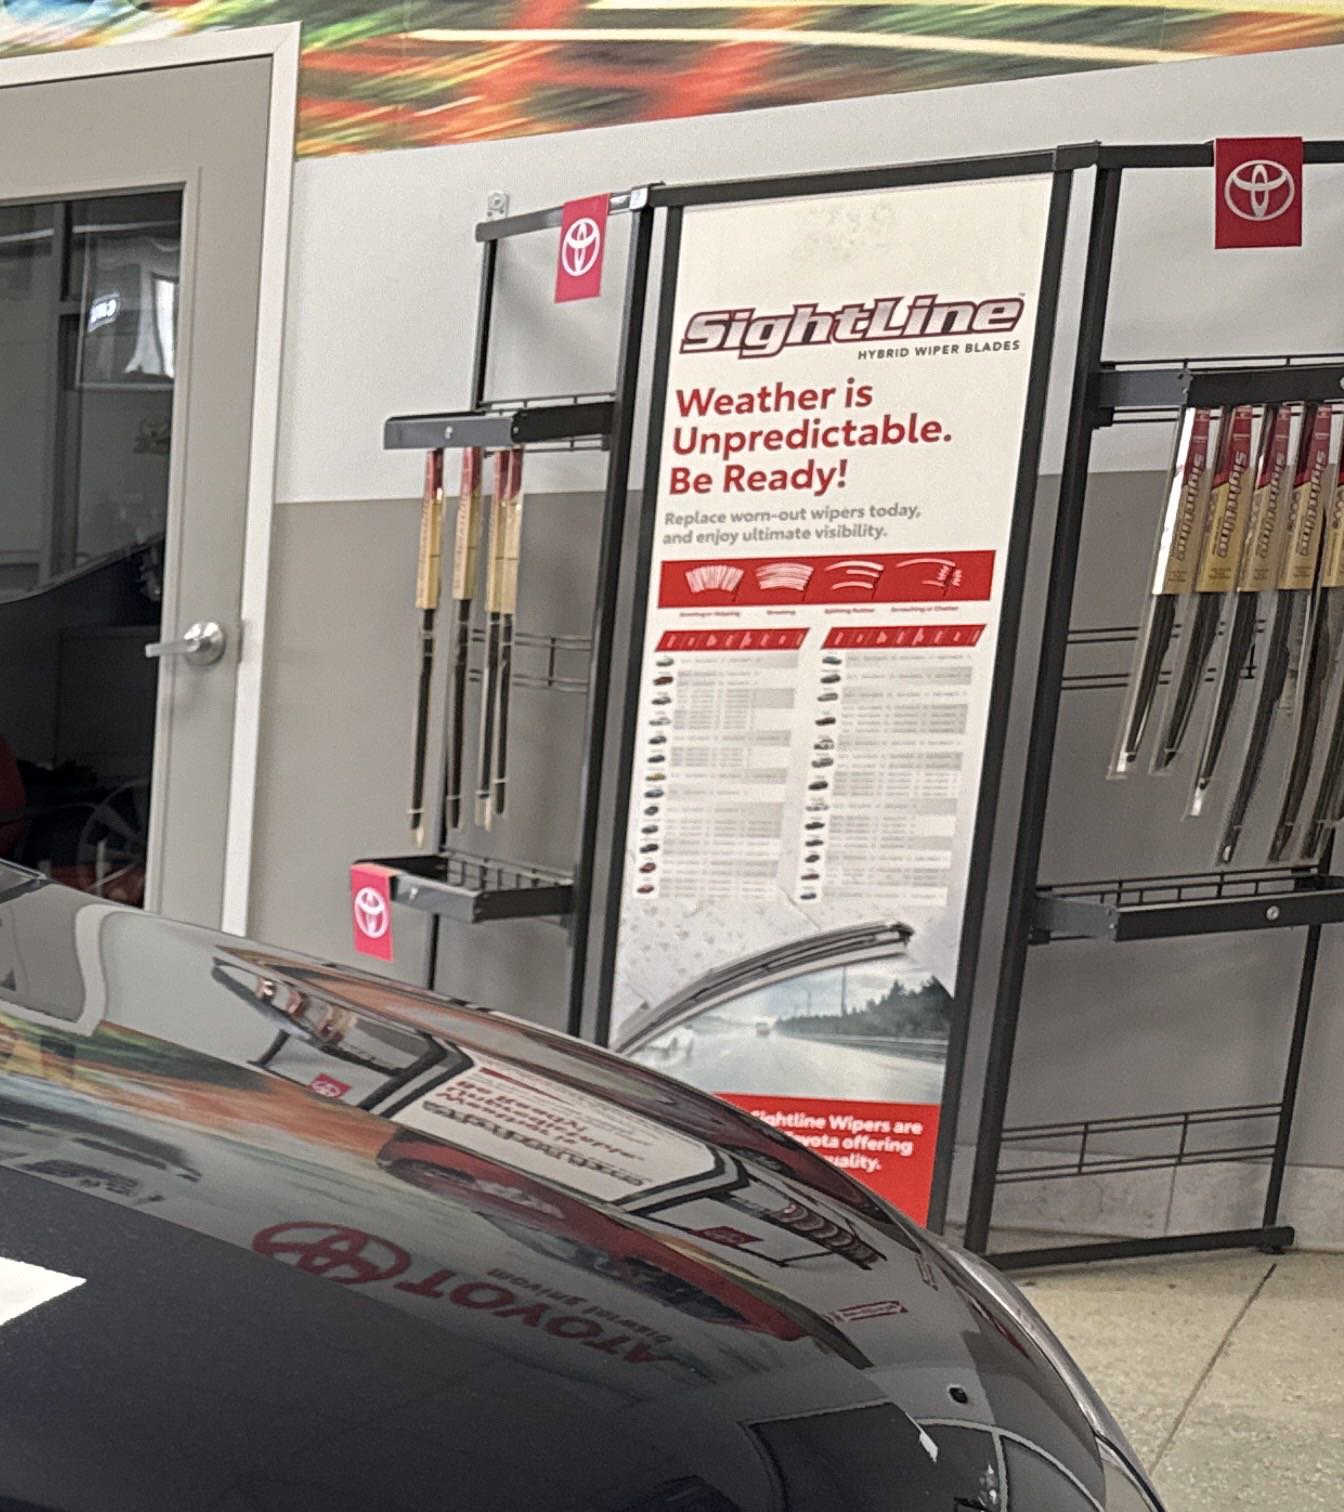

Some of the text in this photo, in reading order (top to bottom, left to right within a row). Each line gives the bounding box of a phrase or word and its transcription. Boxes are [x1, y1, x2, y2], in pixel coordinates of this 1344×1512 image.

[679, 292, 1025, 360] SightLine
[857, 340, 1021, 361] HYBRID WIPER BLADES
[676, 378, 873, 418] Weather is
[672, 413, 953, 461] Unpredictable.
[669, 459, 848, 497] Be Ready!
[665, 502, 922, 528] Replace worn-out wipers today,
[662, 524, 888, 546] and enjoy ultimate visibility.
[829, 1115, 890, 1134] Wipers
[893, 1121, 923, 1135] are
[842, 1135, 913, 1157] offering
[825, 1154, 881, 1173] uality.
